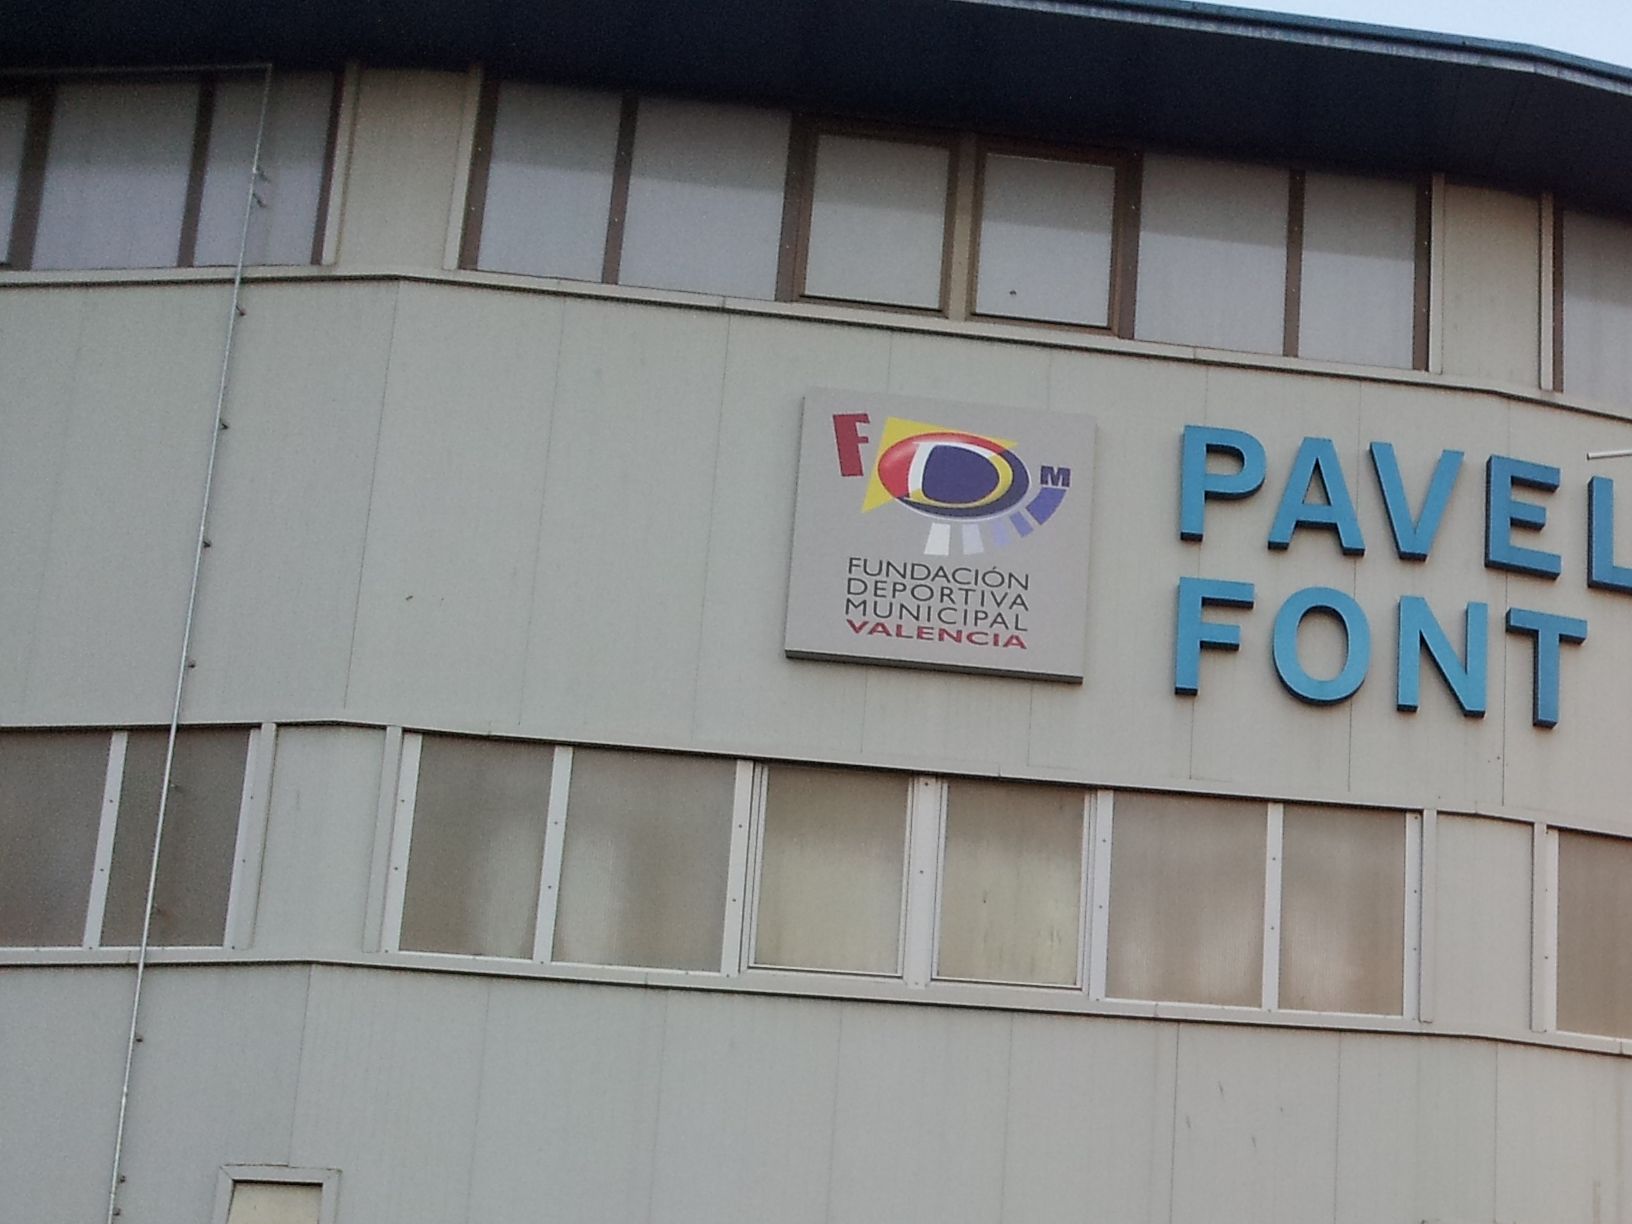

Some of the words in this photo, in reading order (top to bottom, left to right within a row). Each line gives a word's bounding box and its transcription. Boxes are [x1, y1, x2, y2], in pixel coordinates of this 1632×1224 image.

[848, 557, 1029, 591] FUNDACIÓN
[847, 577, 1029, 611] DEPORTIVA
[845, 599, 1028, 632] MUNICIPAL
[846, 619, 1027, 649] VALENCIA
[1175, 577, 1588, 728] FONT
